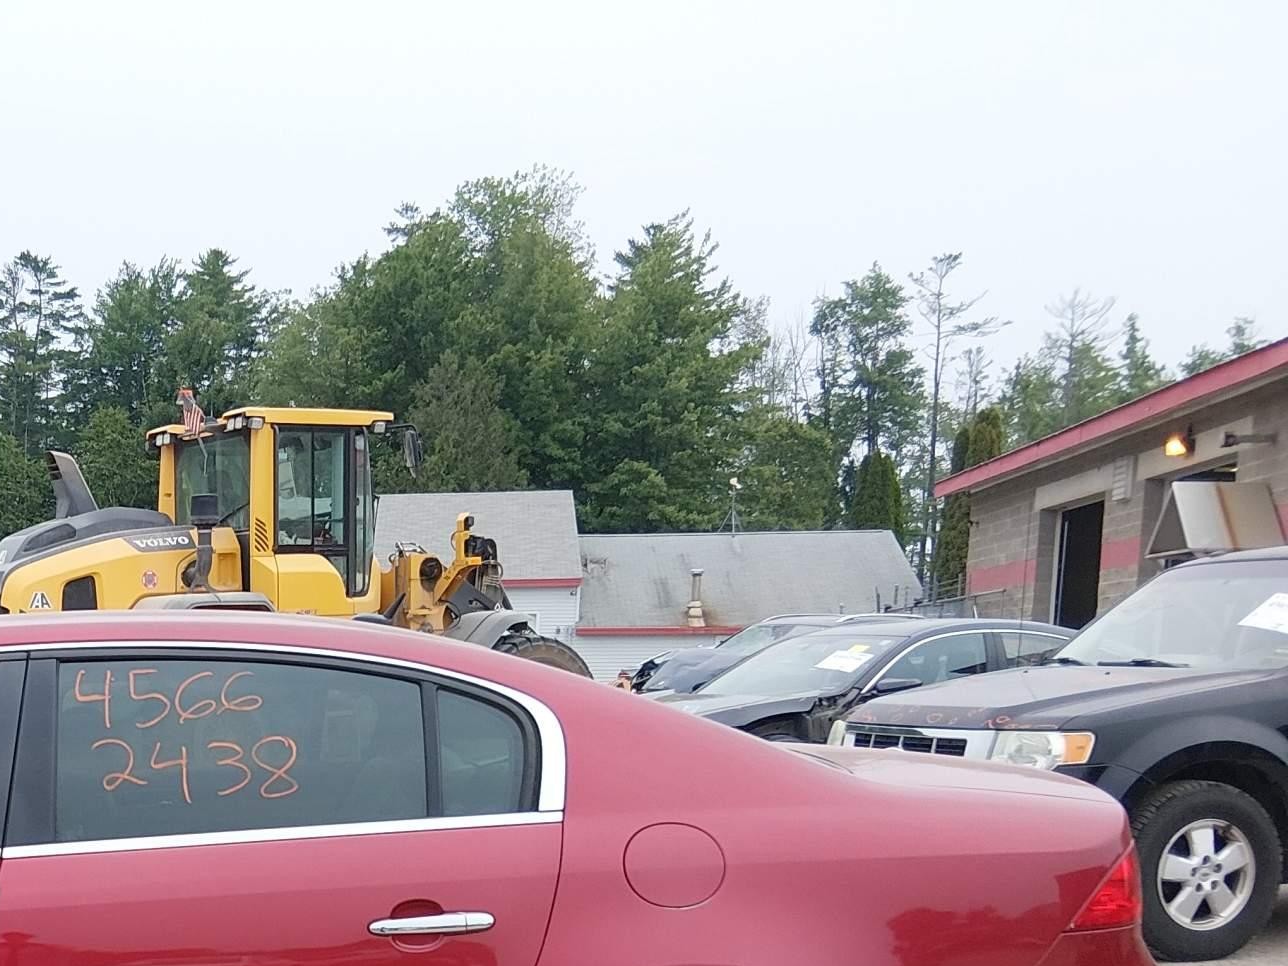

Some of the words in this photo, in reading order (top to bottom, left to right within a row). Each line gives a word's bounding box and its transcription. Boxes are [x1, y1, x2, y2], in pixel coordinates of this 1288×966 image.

[132, 535, 190, 548] VOLVO
[74, 669, 263, 729] 4566
[91, 735, 299, 804] 2438
